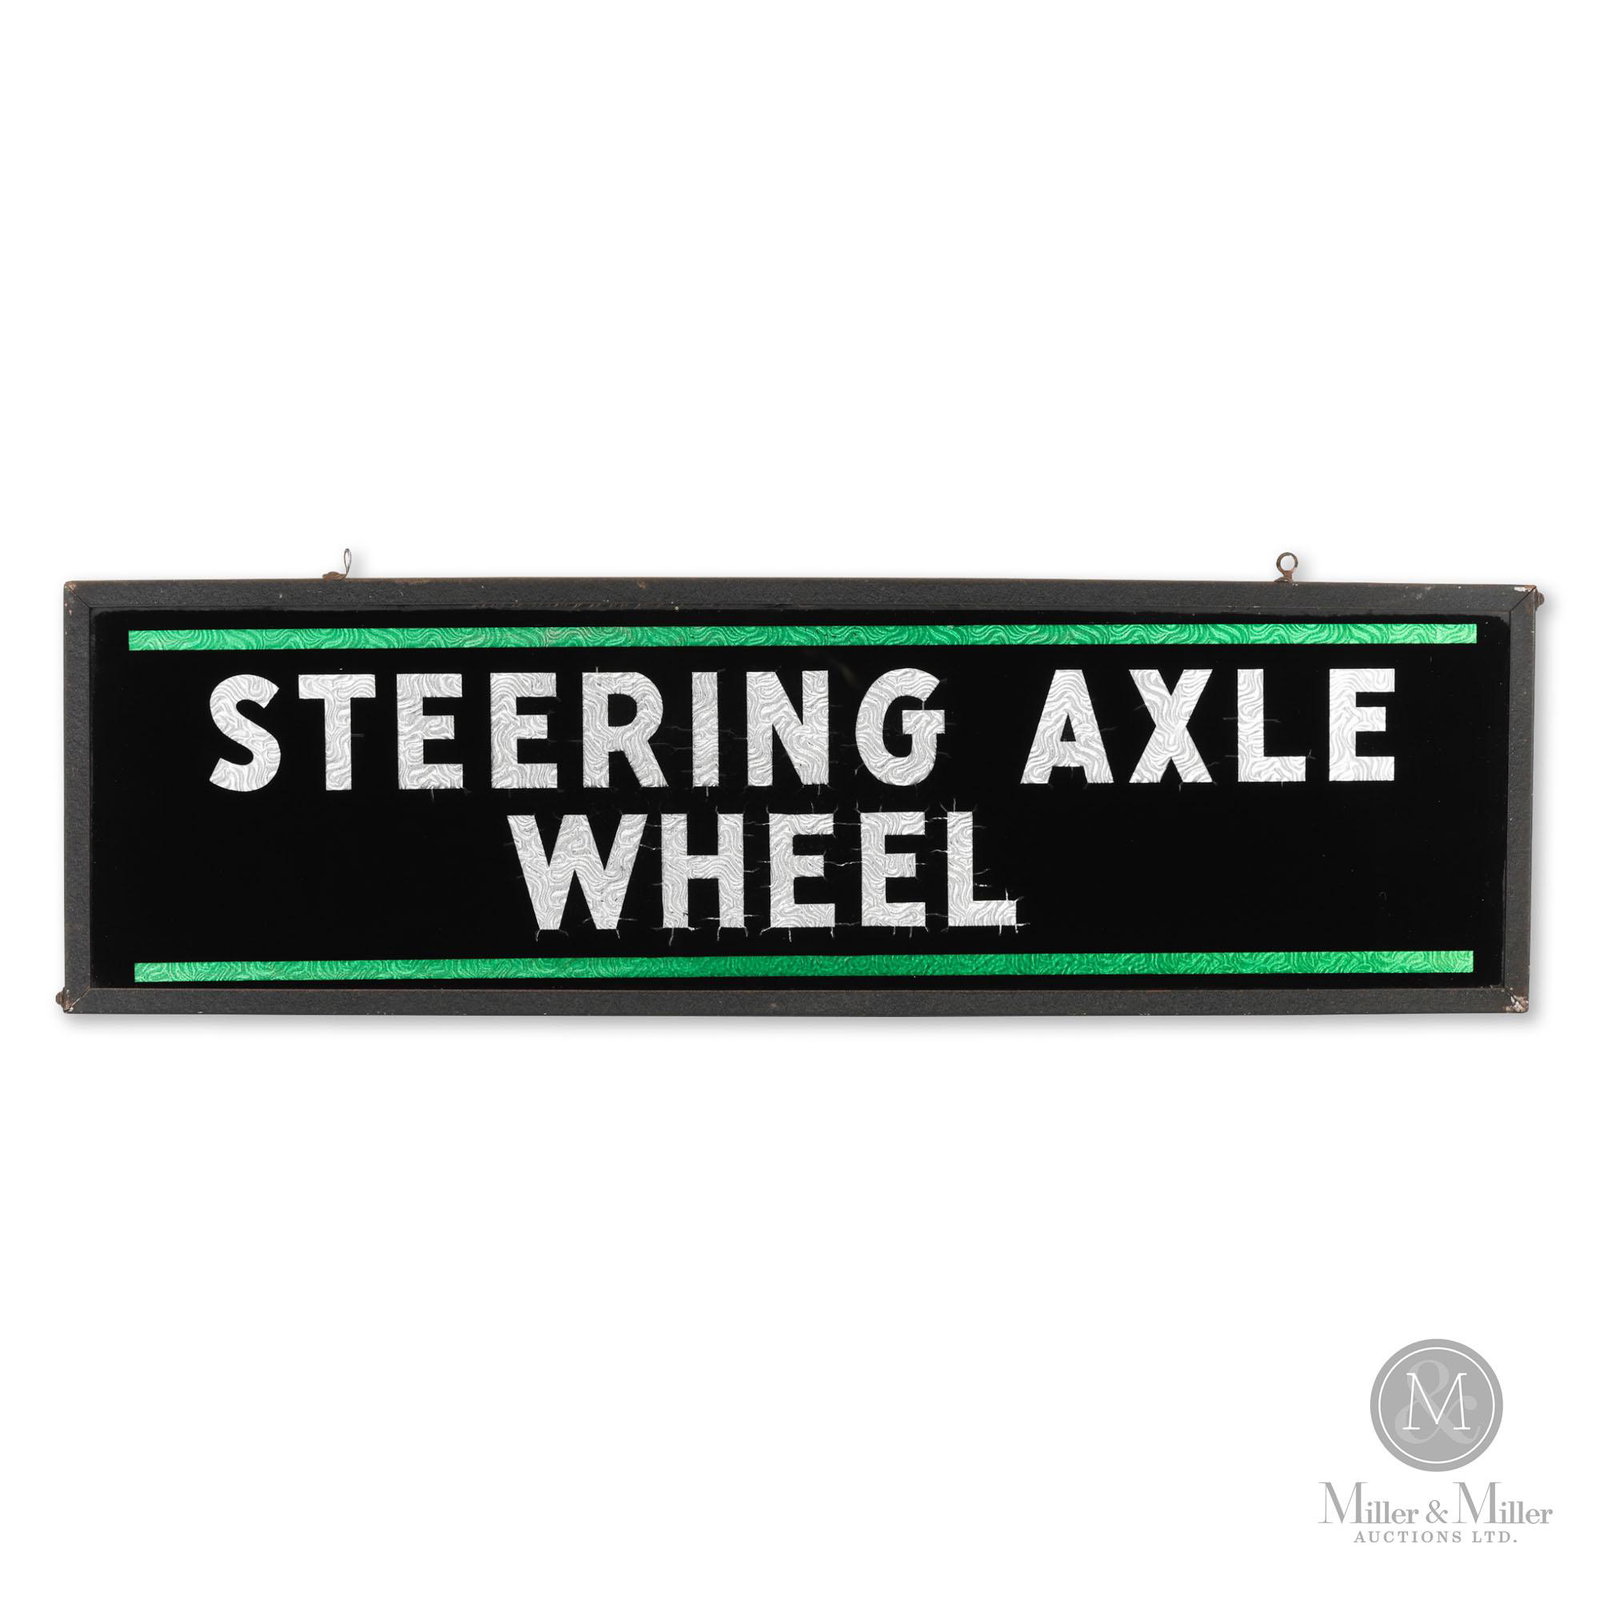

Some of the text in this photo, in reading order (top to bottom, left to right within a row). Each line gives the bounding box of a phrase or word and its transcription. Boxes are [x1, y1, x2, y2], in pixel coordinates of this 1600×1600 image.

[208, 668, 1396, 793] STEERING AXLE
[507, 810, 1020, 934] WHEEL
